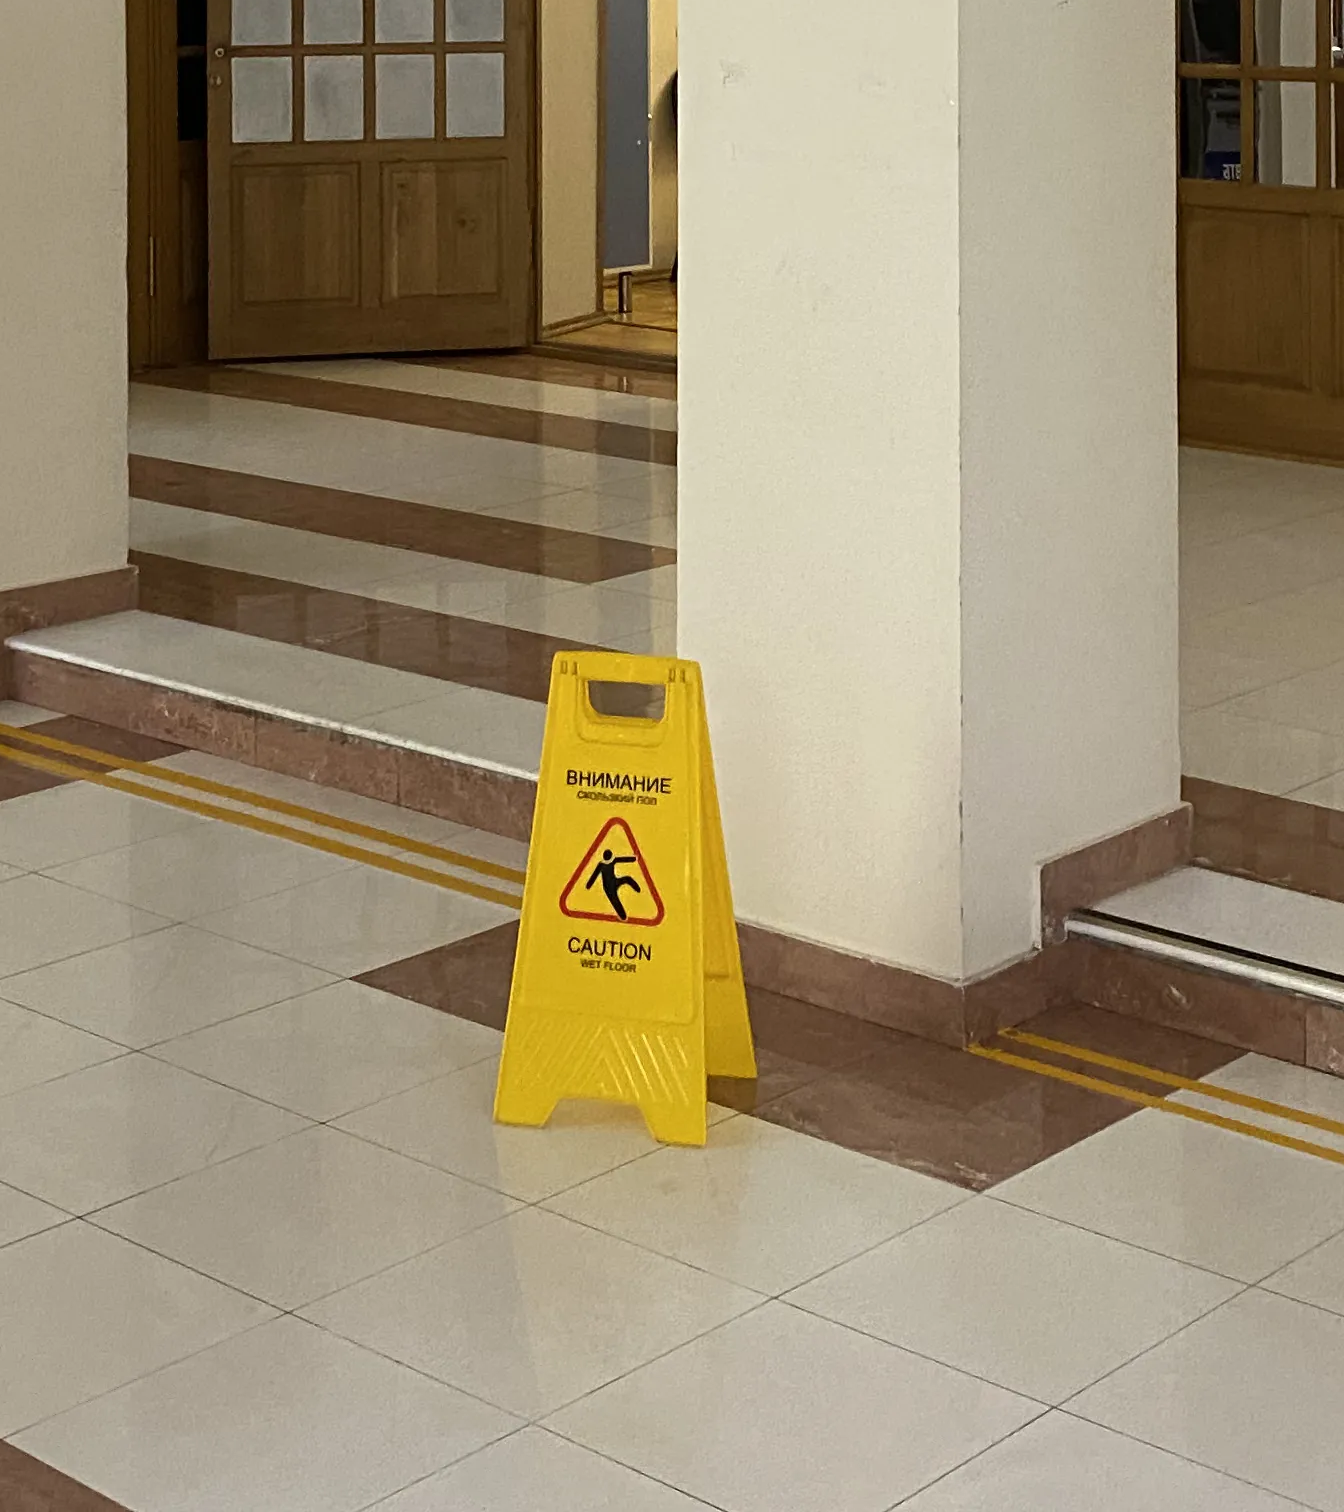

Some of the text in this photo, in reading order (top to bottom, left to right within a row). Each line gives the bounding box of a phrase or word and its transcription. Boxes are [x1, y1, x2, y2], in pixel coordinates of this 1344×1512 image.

[566, 769, 673, 795] ВНИМАНИЕ
[568, 936, 652, 962] CAUTION
[579, 958, 637, 974] WET FLOOR
